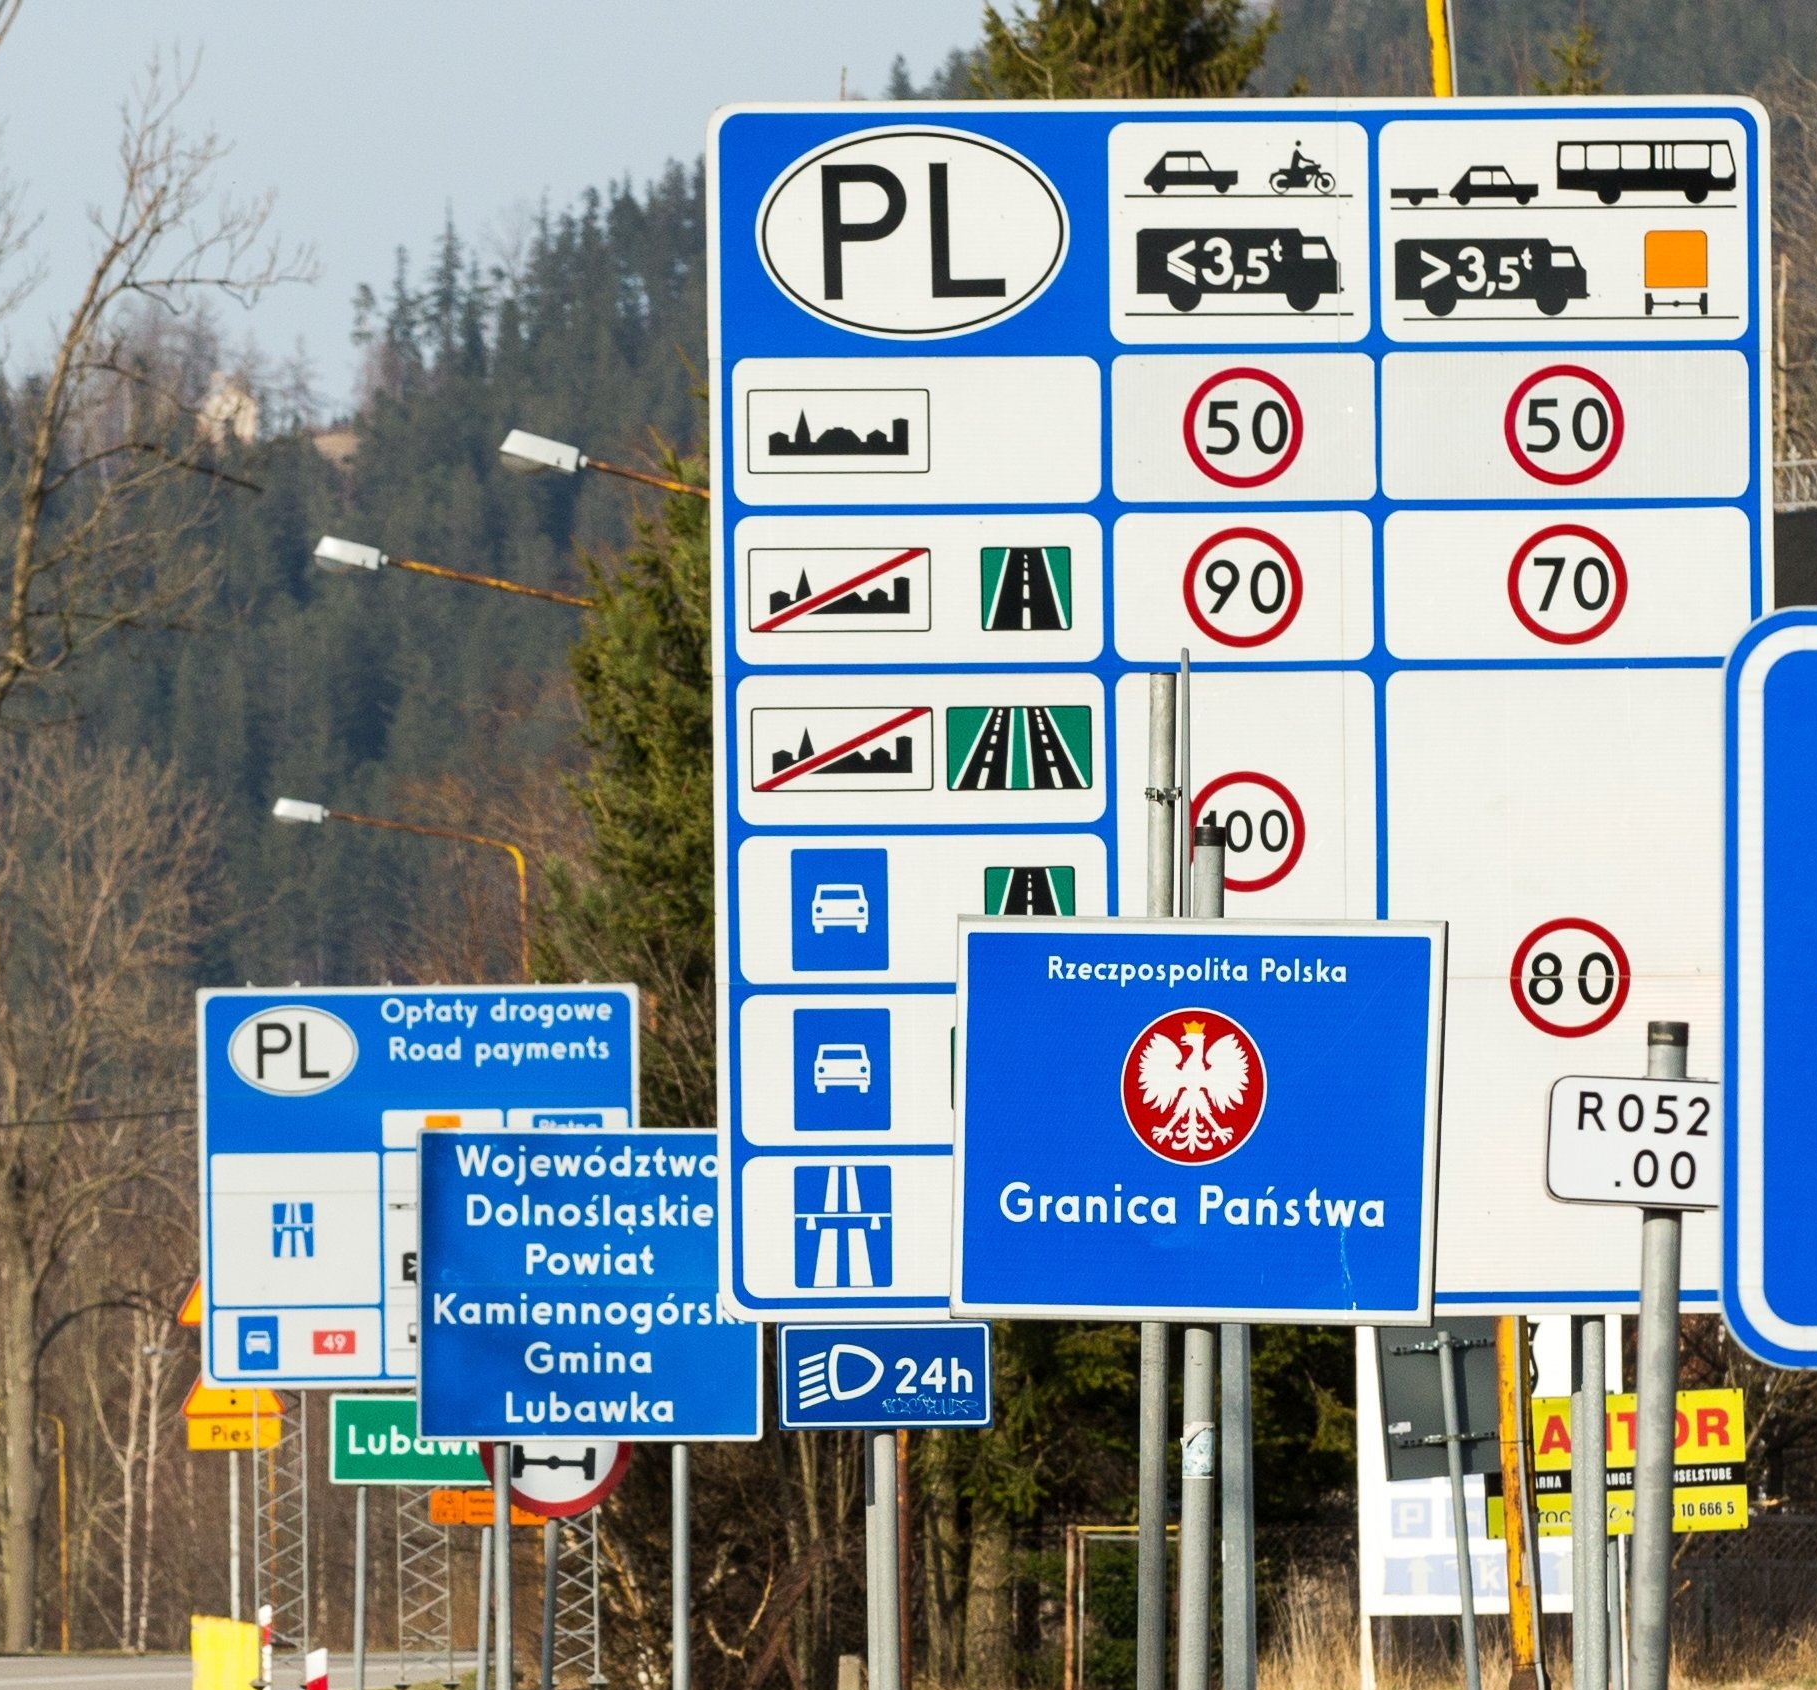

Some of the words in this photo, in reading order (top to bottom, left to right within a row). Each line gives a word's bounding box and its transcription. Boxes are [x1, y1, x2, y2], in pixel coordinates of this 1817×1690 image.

[821, 162, 1006, 301] PL
[1206, 400, 1289, 456] 50
[1526, 397, 1609, 453] 50
[1205, 559, 1286, 614] 90
[1533, 557, 1610, 612] 70
[1048, 955, 1248, 988] Rzeczpospolita
[1261, 957, 1347, 983] Polska
[1528, 952, 1615, 1006] 80
[380, 998, 478, 1029] Opłaty
[490, 997, 612, 1028] drogowe
[256, 1022, 330, 1079] PL
[389, 1036, 462, 1061] Road
[475, 1036, 610, 1067] payments
[455, 1144, 718, 1186] Województwo
[466, 1194, 714, 1235] Dolnośląskie
[999, 1181, 1177, 1226] Granica
[1199, 1184, 1385, 1228] Państwa
[525, 1243, 654, 1276] Powiat
[433, 1292, 745, 1335] Kamiennogórsk
[322, 1333, 347, 1351] 49
[524, 1341, 652, 1374] Gmina
[894, 1357, 973, 1394] 24h
[505, 1391, 674, 1424] Lubawka
[212, 1425, 250, 1442] Pies
